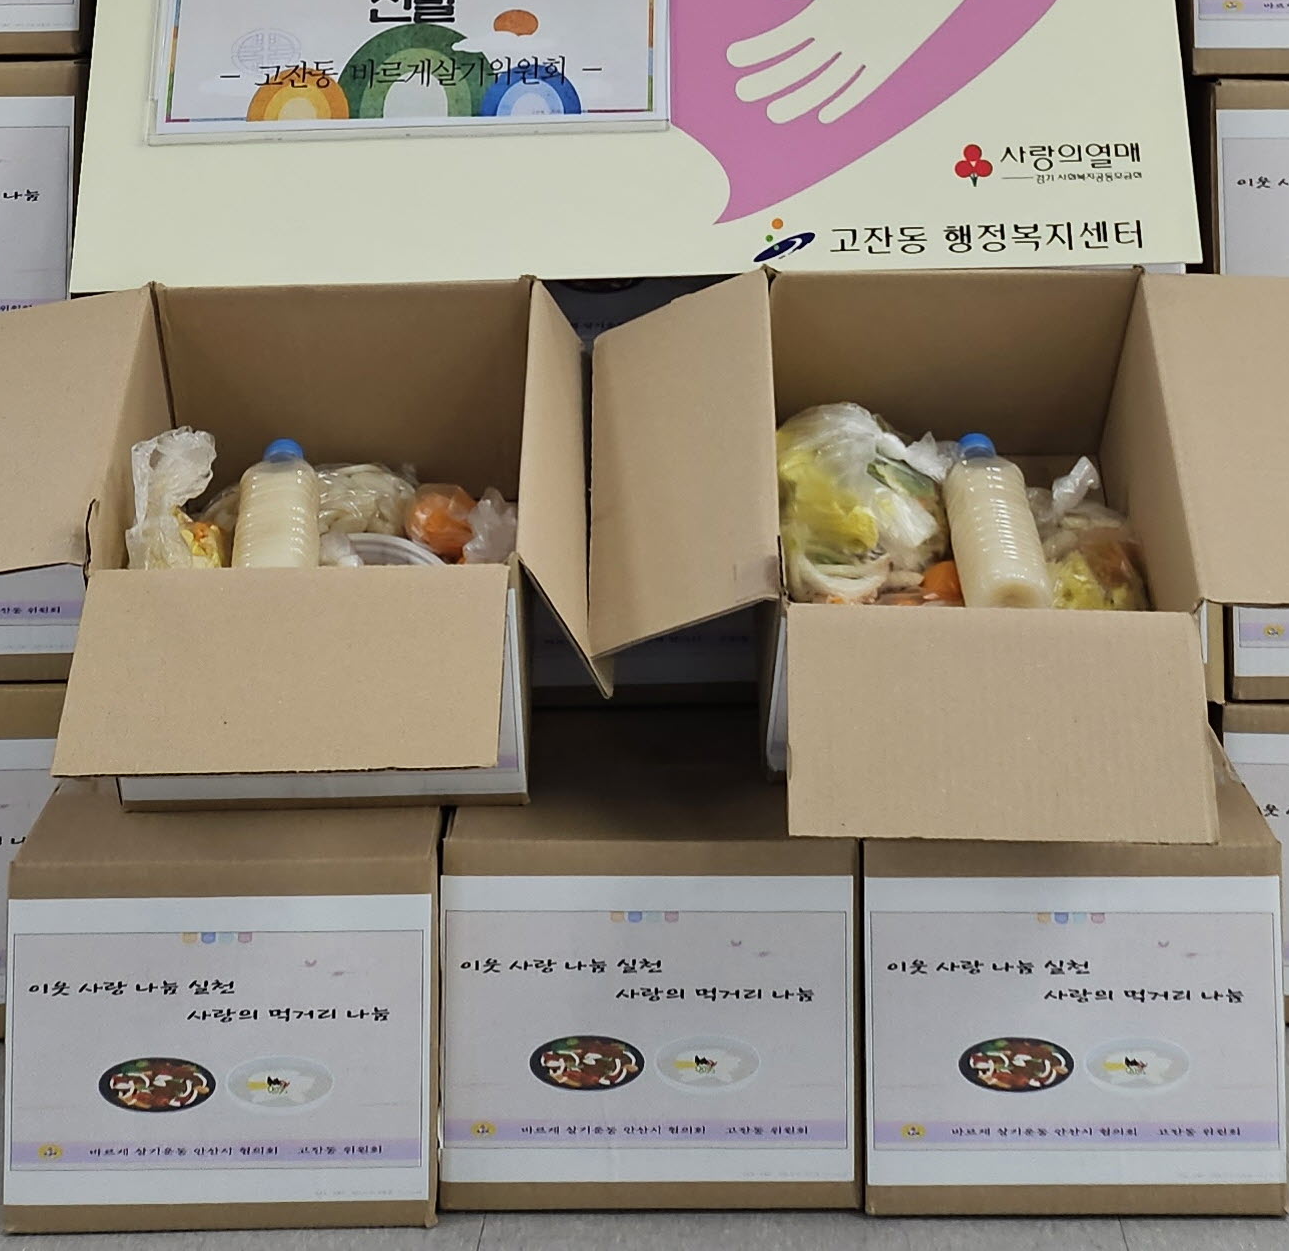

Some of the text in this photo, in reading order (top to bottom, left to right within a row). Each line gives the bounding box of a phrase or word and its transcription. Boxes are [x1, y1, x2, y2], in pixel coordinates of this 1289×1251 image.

[255, 55, 566, 88] 고잔동 바르게살기위원회
[1000, 143, 1141, 171] 사랑의열매
[3, 189, 40, 201] 나눔
[830, 219, 1144, 255] 고잔동 행정복지센터
[461, 958, 662, 973] 이웃 사랑 나눔 실천
[887, 960, 1090, 975] 이웃 사랑 나눔 실천
[29, 979, 235, 996] 이웃 사랑 나눔 실천
[616, 987, 814, 1002] 사랑의 먹거리 나눔
[1044, 988, 1244, 1003] 사랑의 먹거리 나눔
[187, 1007, 390, 1023] 사랑의 먹거리 나눔
